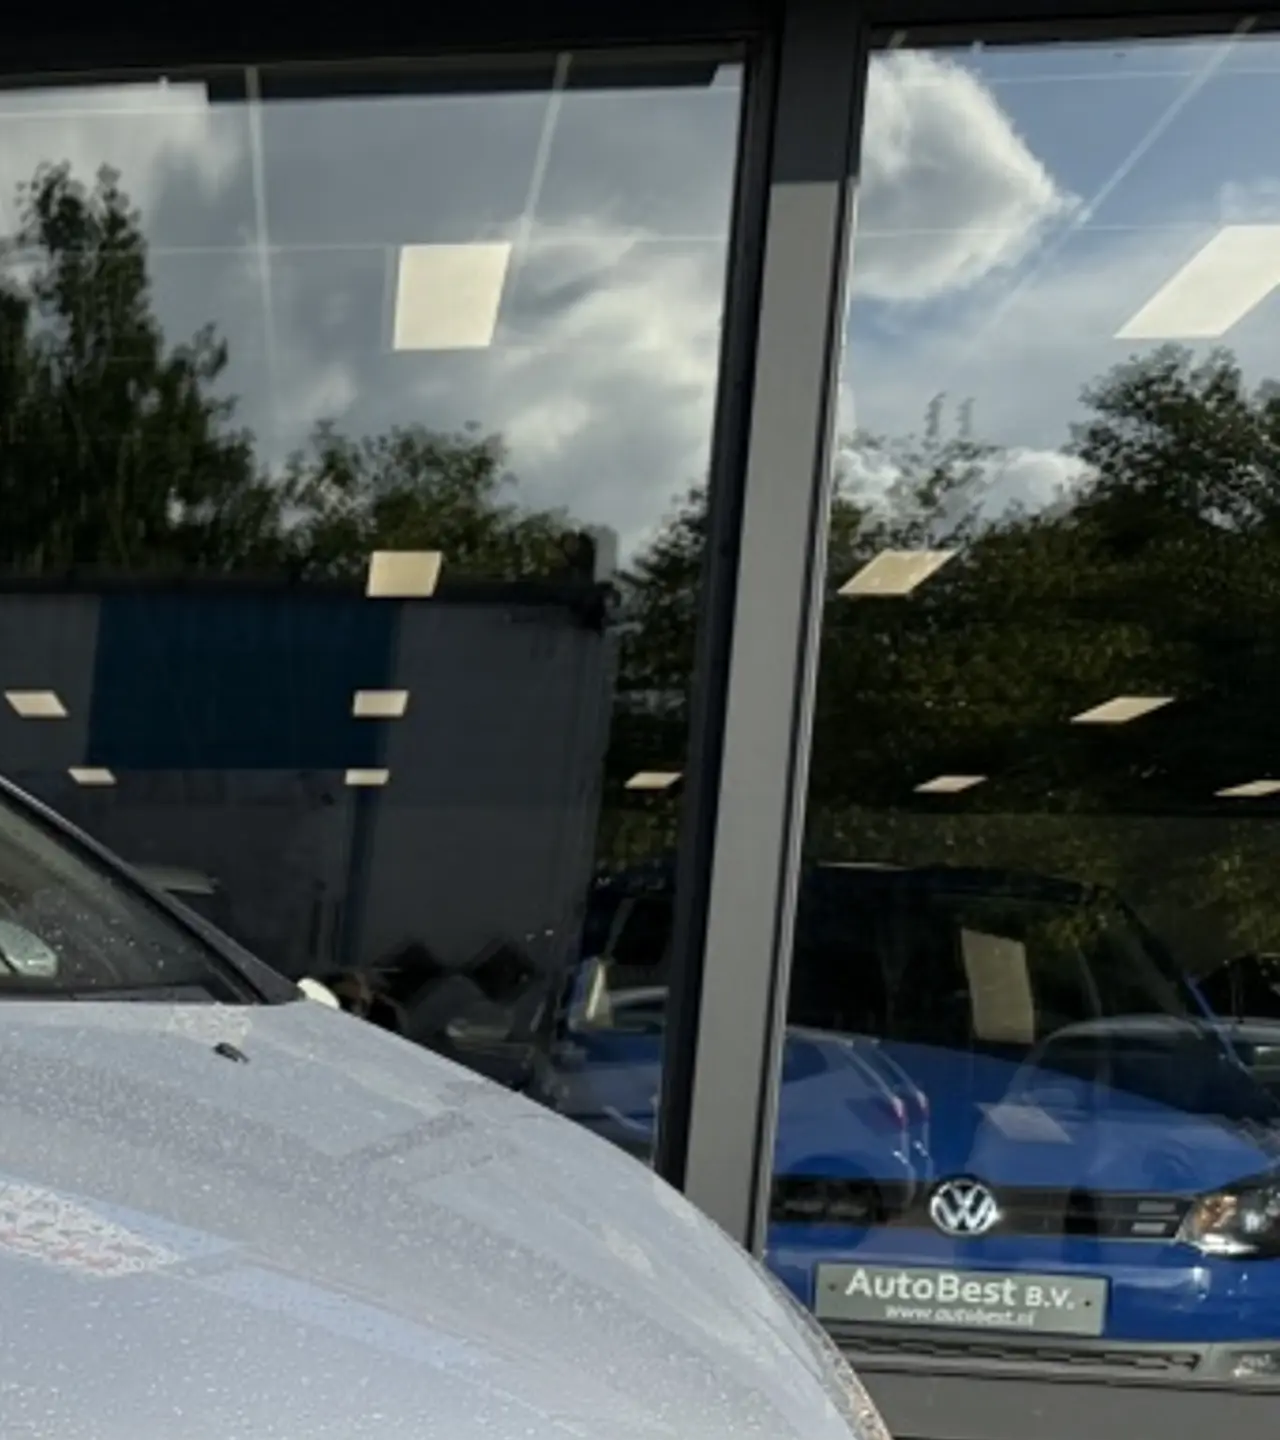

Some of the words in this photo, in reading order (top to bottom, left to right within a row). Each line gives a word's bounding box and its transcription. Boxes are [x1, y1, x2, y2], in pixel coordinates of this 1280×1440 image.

[845, 1268, 1018, 1306] AutoBest
[1024, 1285, 1076, 1310] B.V.
[884, 1304, 1038, 1327] www.autobest.nl
